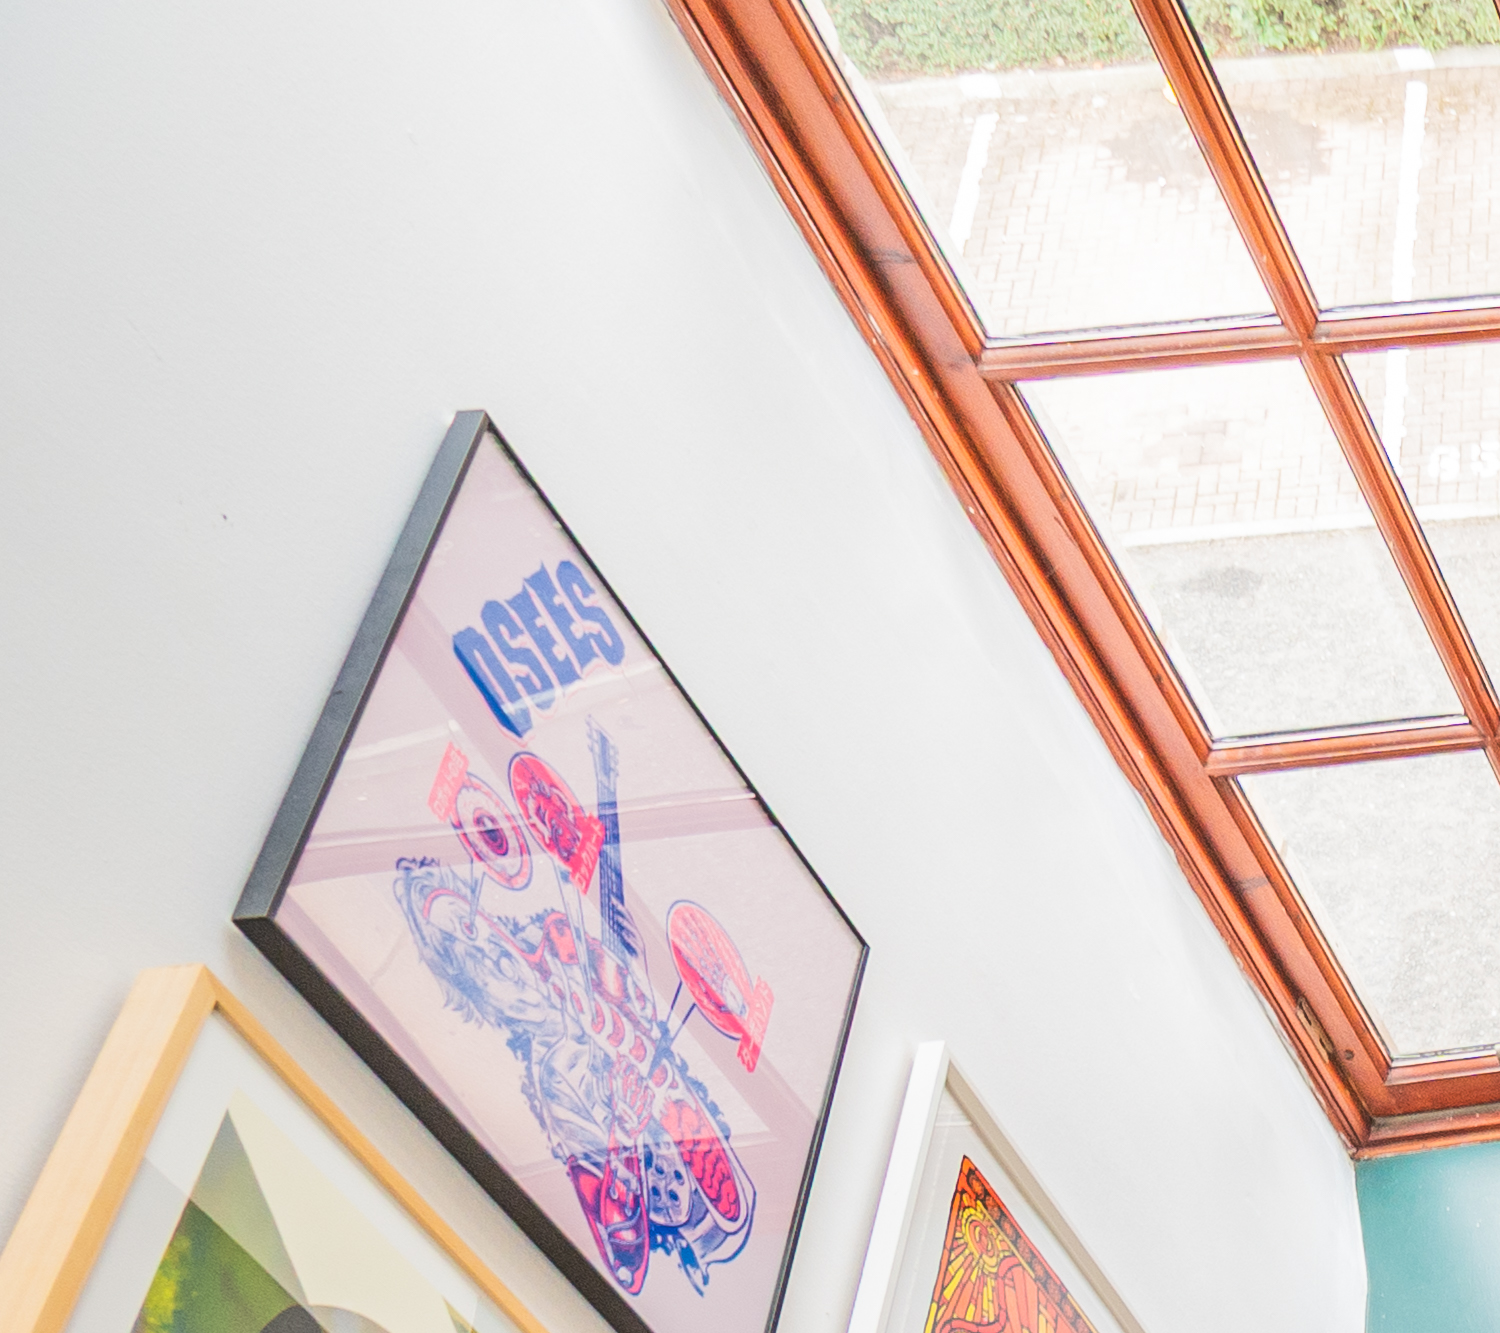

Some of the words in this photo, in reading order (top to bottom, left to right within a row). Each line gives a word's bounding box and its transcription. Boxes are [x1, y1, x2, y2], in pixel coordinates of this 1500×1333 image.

[453, 556, 628, 741] OSEES
[572, 815, 605, 893] ロックハート
